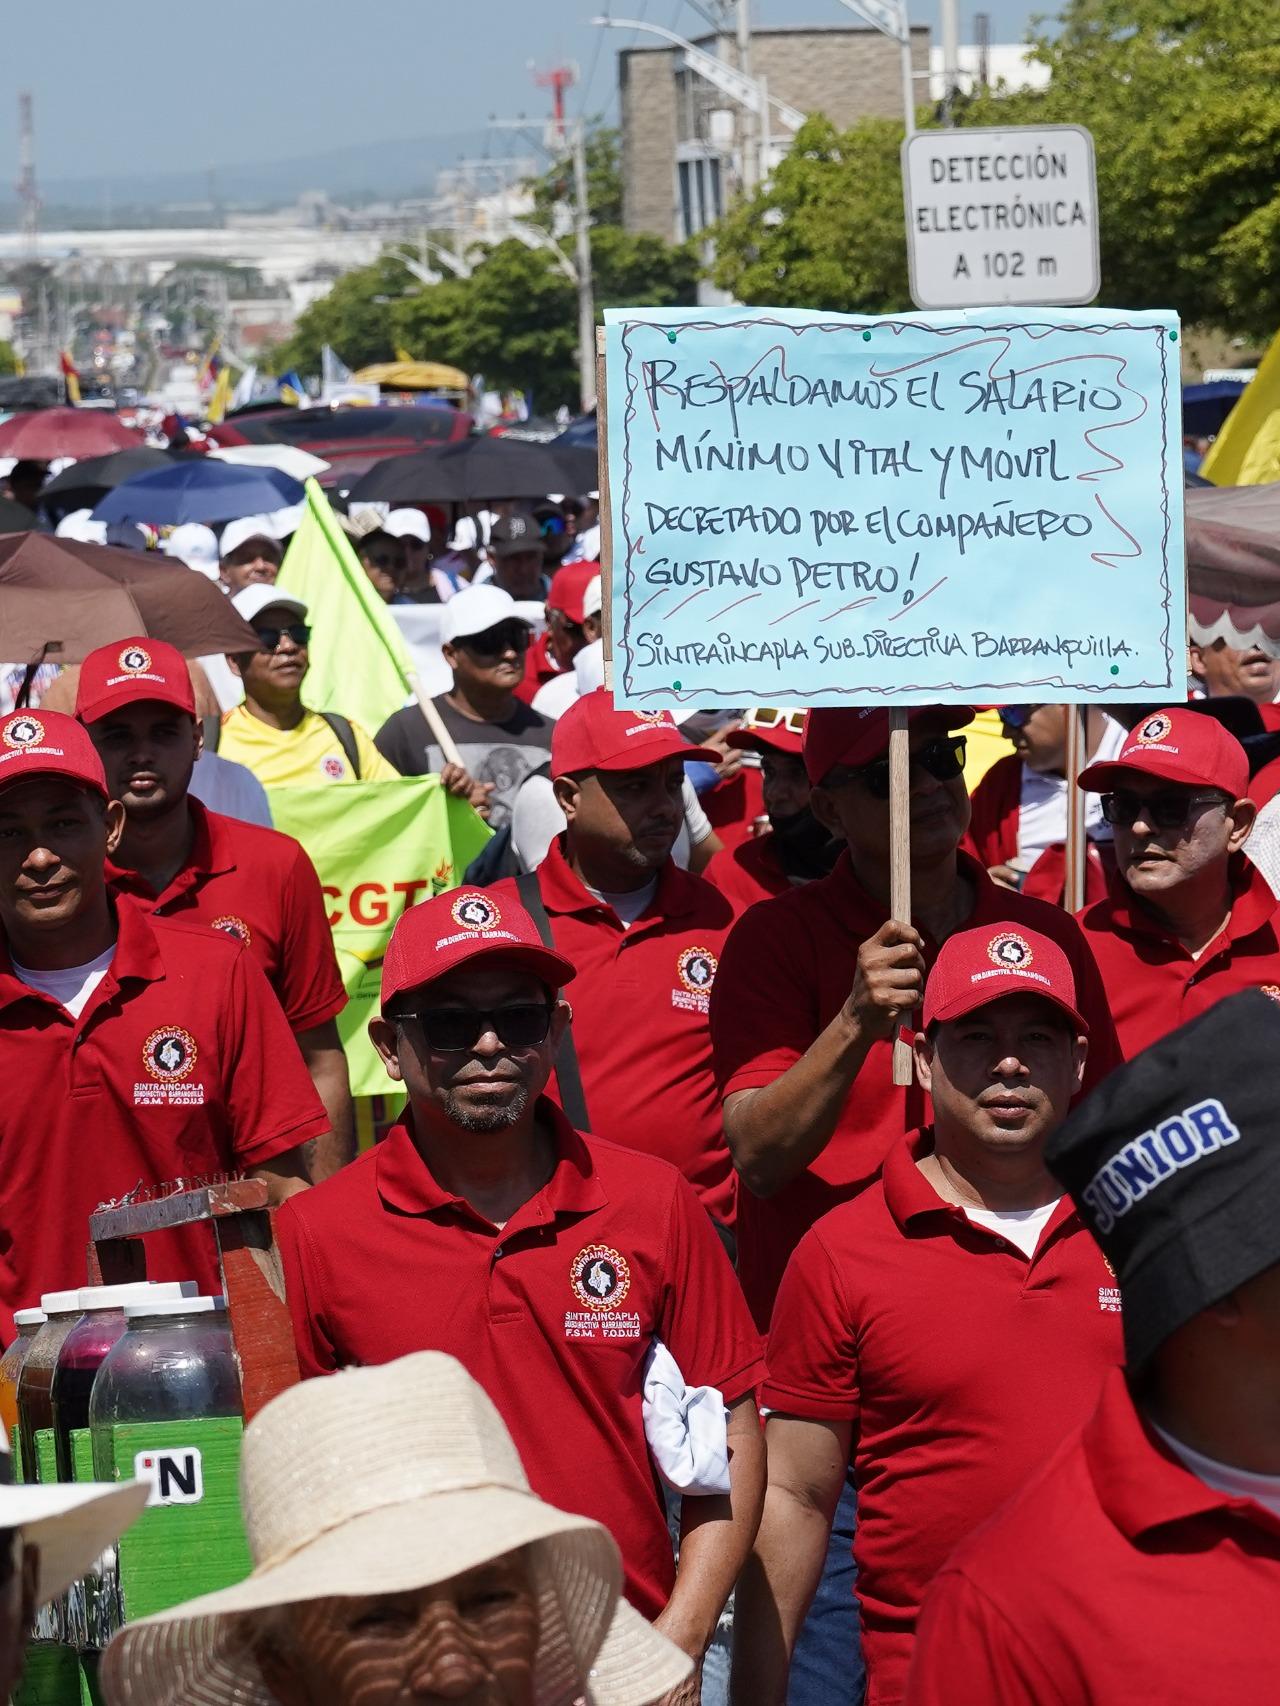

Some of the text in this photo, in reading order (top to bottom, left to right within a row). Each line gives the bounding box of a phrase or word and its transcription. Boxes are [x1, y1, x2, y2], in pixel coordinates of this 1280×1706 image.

[930, 145, 1067, 184] DETECCIÓN
[917, 194, 1086, 232] ELECTRÓNICA
[953, 252, 1057, 279] A 102 m
[644, 502, 801, 536] DECRETADO
[645, 557, 782, 589] GUSTAVO
[134, 1083, 204, 1091] SINTRAINCAPLA
[1082, 1098, 1240, 1234] JUNIOR
[565, 1311, 640, 1321] SINTRAINCAPLA
[565, 1328, 595, 1338] F.S.M.
